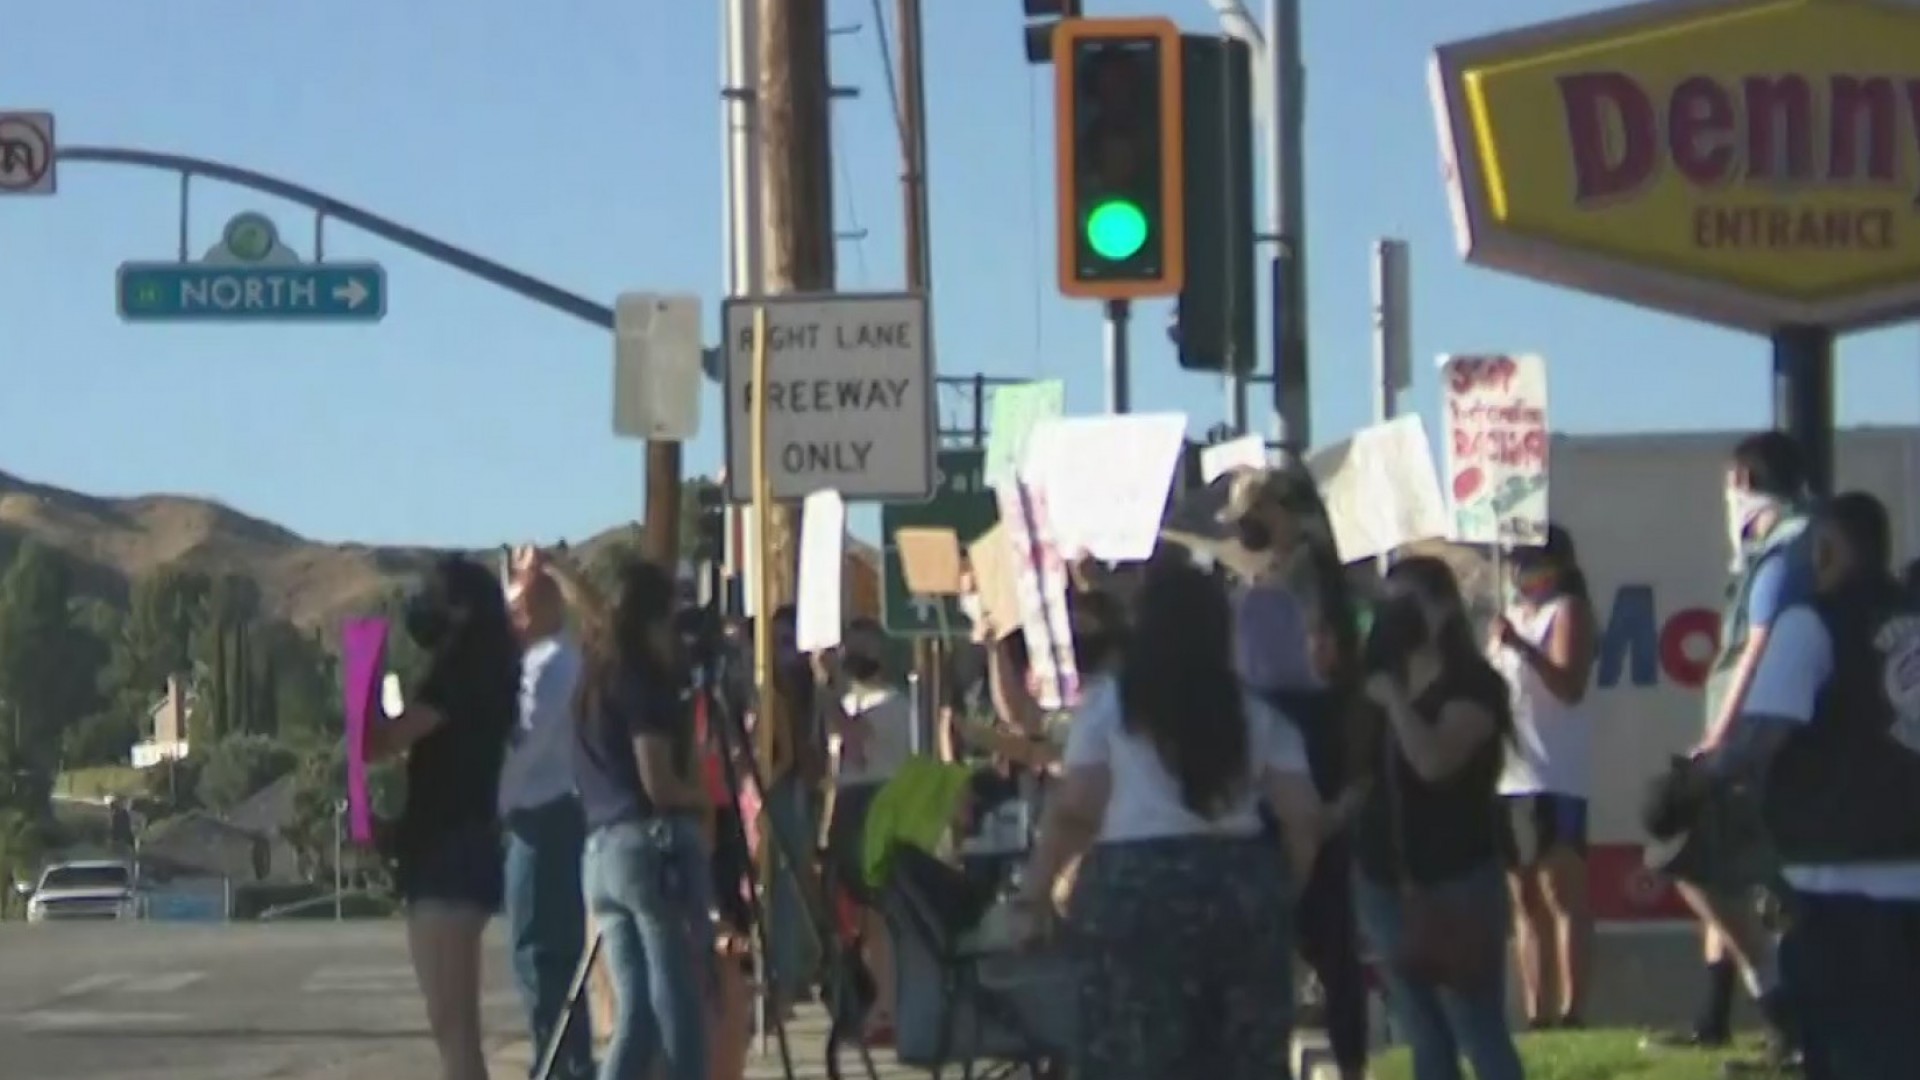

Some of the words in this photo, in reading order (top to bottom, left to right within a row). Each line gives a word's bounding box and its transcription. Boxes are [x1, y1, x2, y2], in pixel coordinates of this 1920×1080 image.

[1554, 70, 1920, 210] Denn
[1694, 206, 1894, 248] ENTRANCE
[180, 276, 317, 308] NORTH
[739, 324, 820, 352] RGHT
[836, 321, 912, 349] LANE
[781, 441, 873, 473] ONLY
